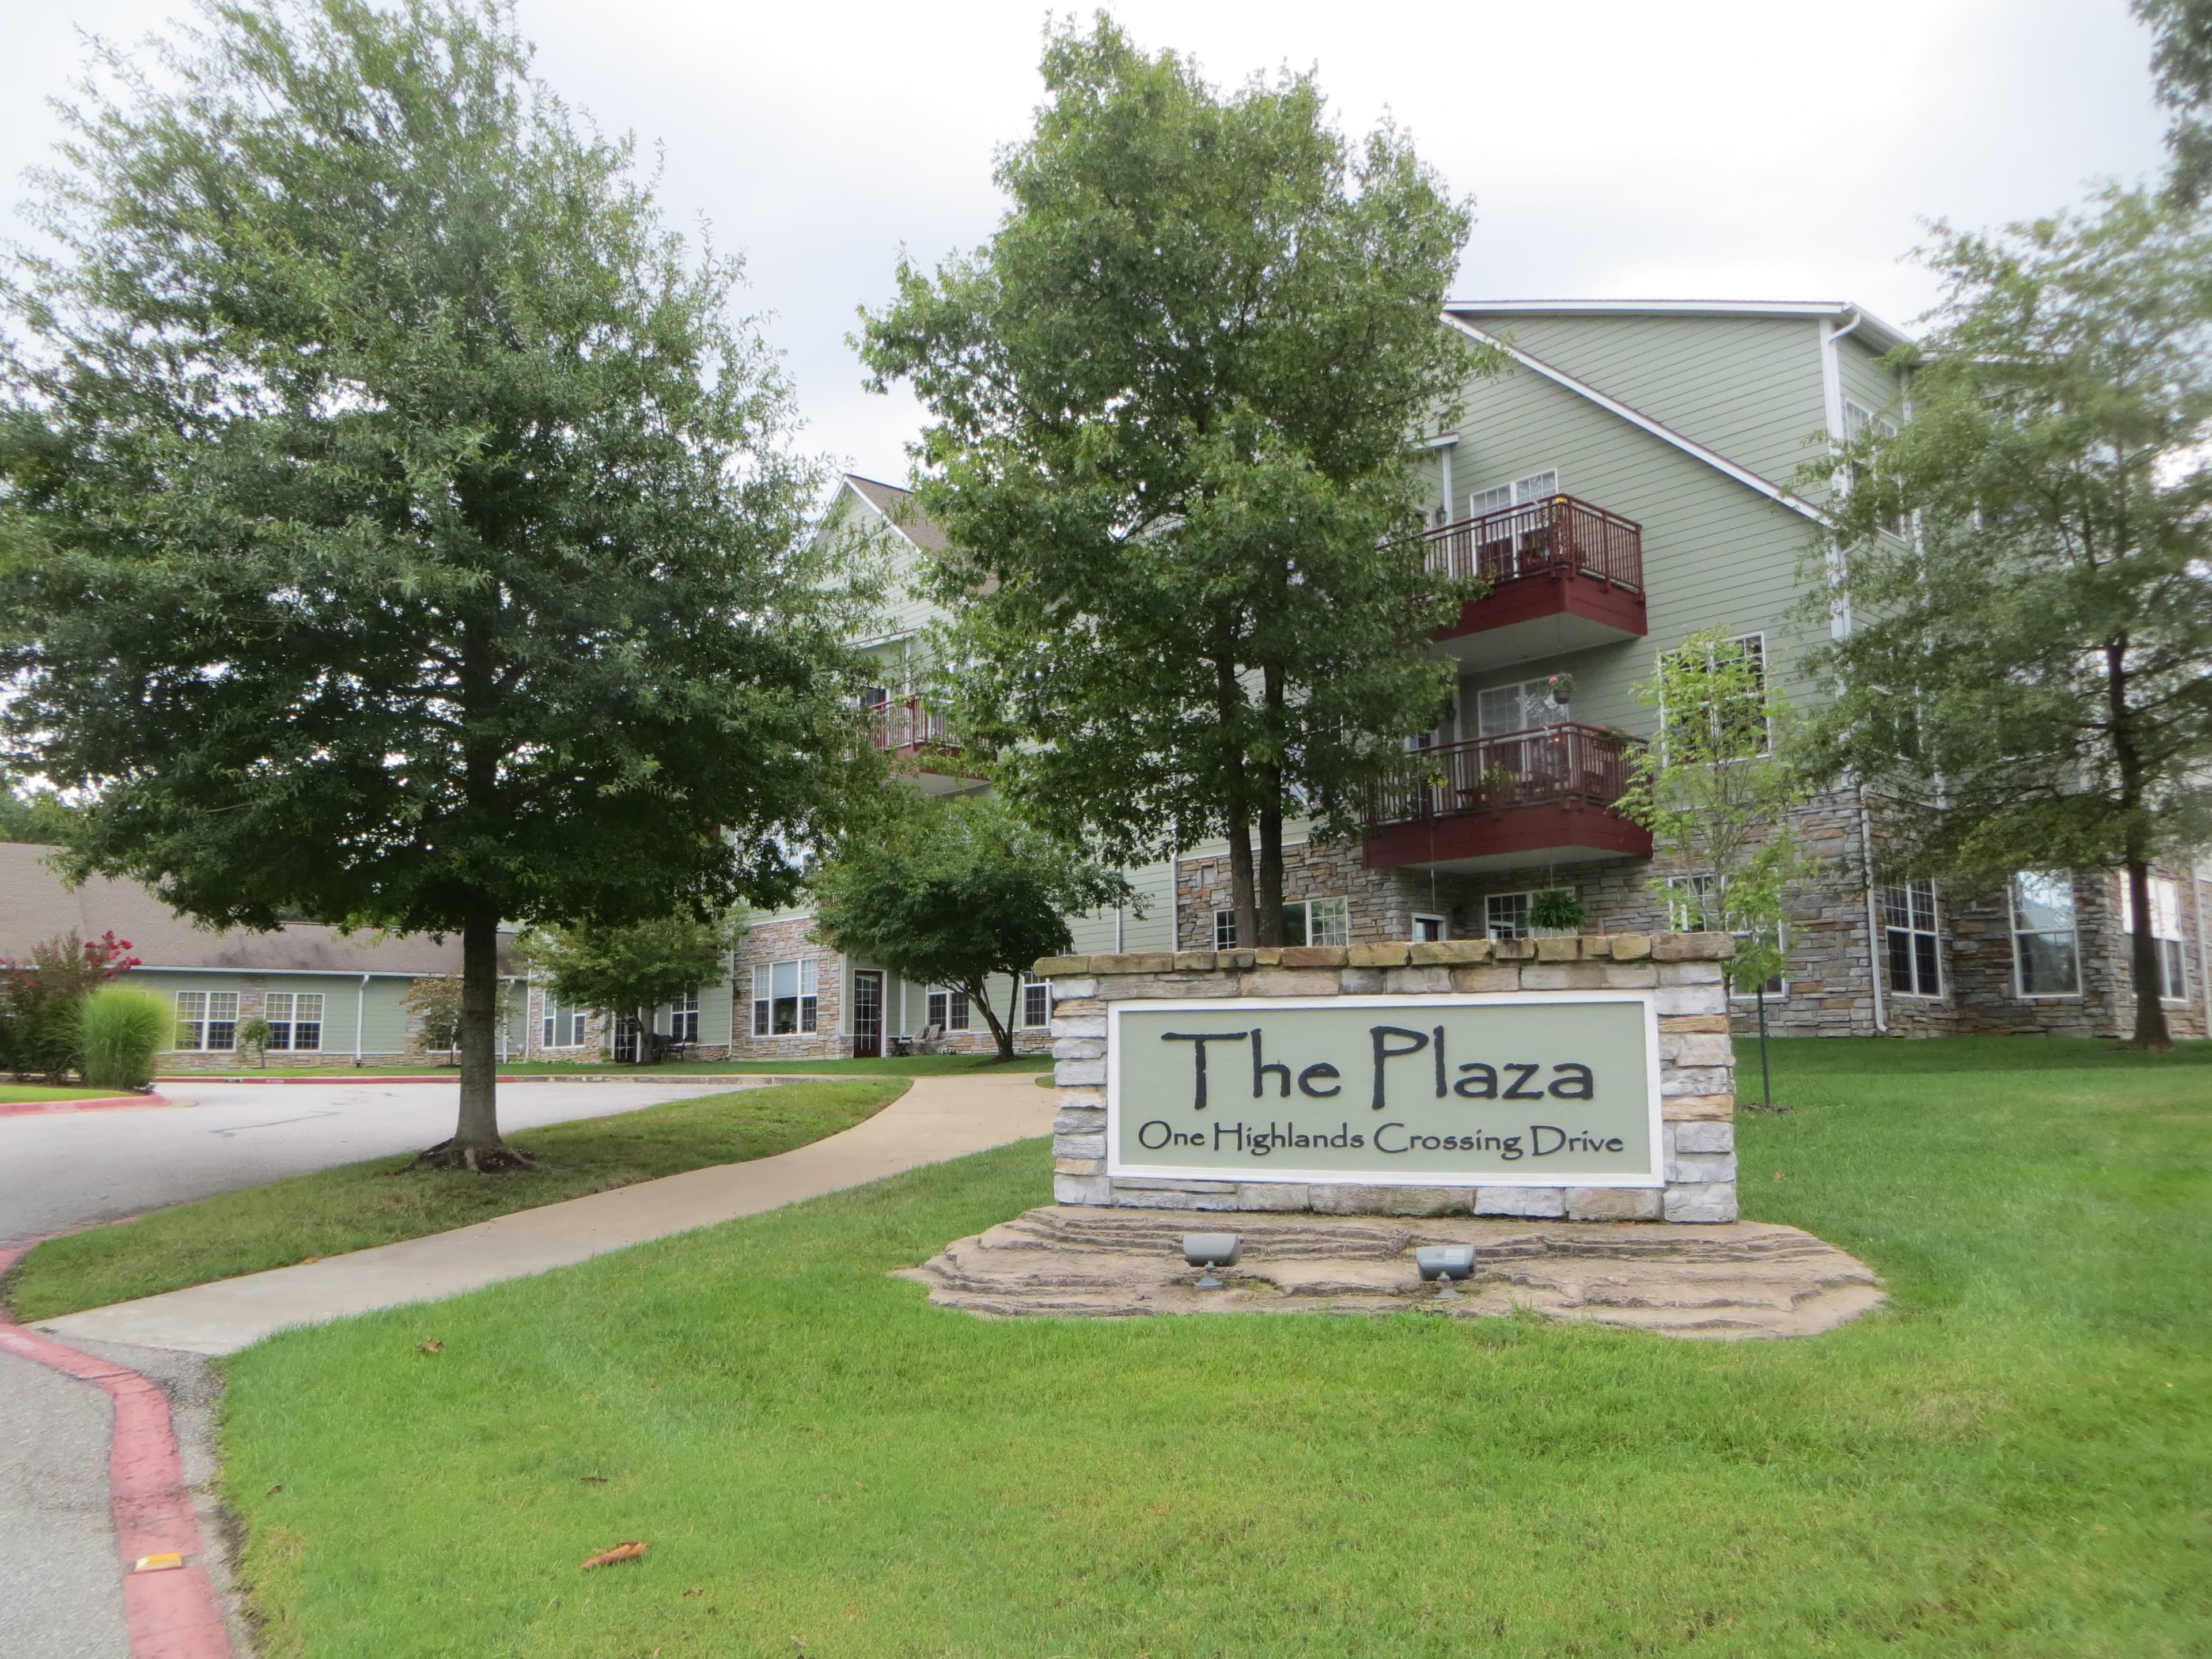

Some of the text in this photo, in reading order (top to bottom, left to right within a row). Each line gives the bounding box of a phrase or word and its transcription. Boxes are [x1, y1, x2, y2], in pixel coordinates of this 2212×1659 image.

[1160, 1025, 1594, 1111] The Plaza
[1138, 1120, 1624, 1161] One Highlands Crossing Drive
